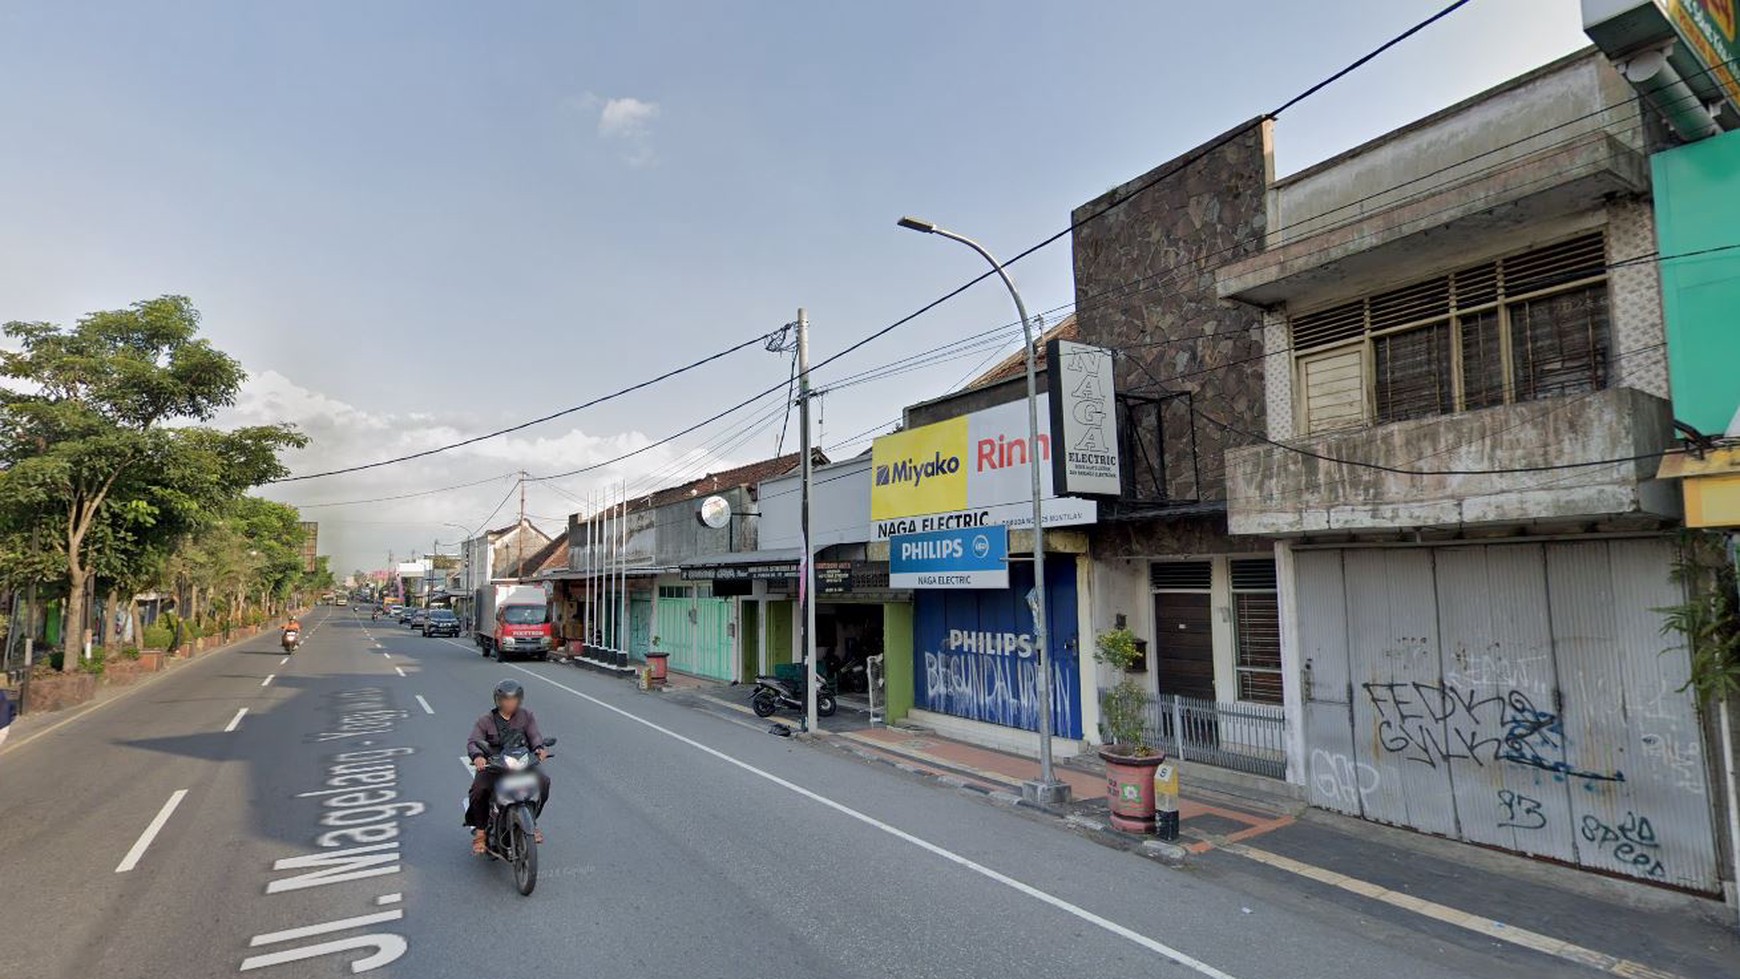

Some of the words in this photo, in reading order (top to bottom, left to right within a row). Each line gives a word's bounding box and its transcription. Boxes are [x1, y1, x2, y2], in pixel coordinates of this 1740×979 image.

[1067, 346, 1109, 453] NAGA
[892, 451, 960, 487] Miyako
[1068, 452, 1117, 466] ELECTRIC
[878, 520, 917, 538] NAGA
[922, 511, 990, 531] ELECTRIC
[902, 538, 963, 561] PHILIPS
[917, 576, 936, 585] NAGA
[938, 575, 971, 585] ELECTRIC
[950, 629, 1032, 658] PHILIPS
